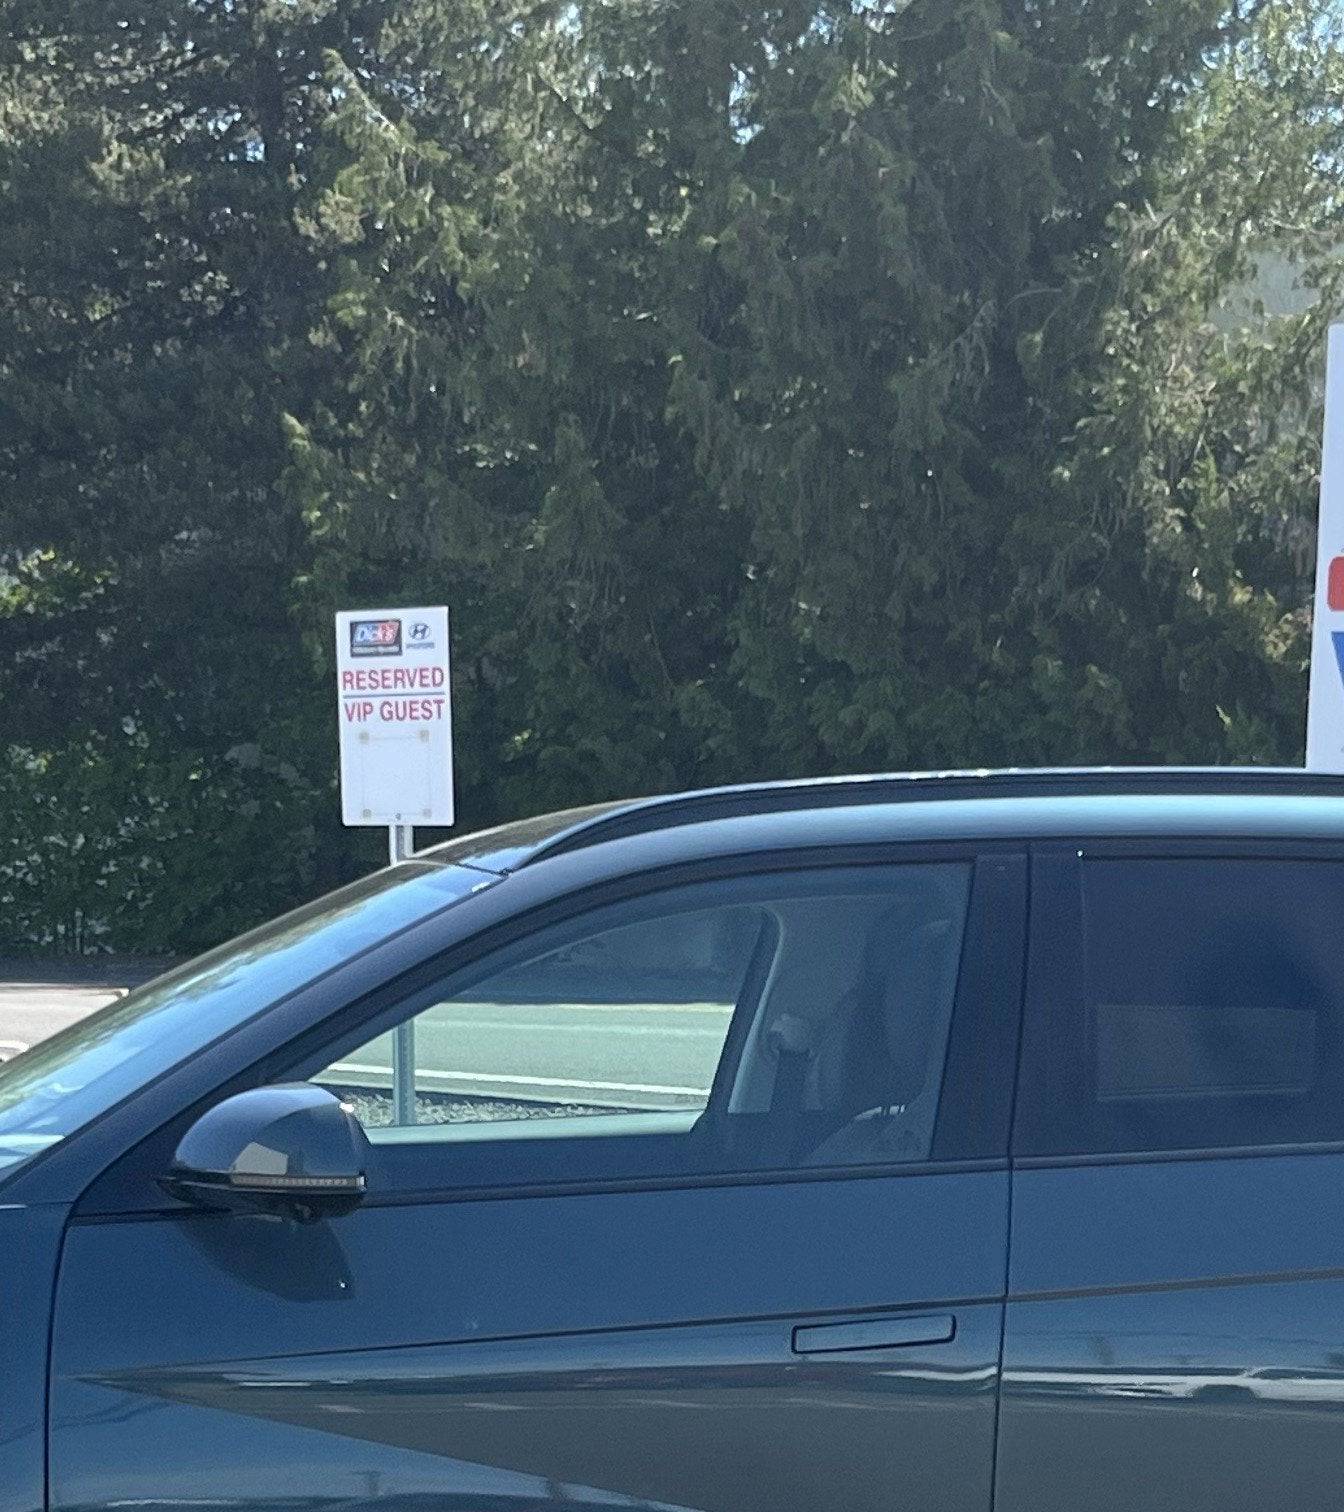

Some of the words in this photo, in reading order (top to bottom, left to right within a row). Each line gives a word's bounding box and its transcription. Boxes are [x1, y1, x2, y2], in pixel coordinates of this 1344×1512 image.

[342, 666, 445, 691] RESERVED
[344, 701, 374, 722] VIP
[379, 700, 445, 722] GUEST
